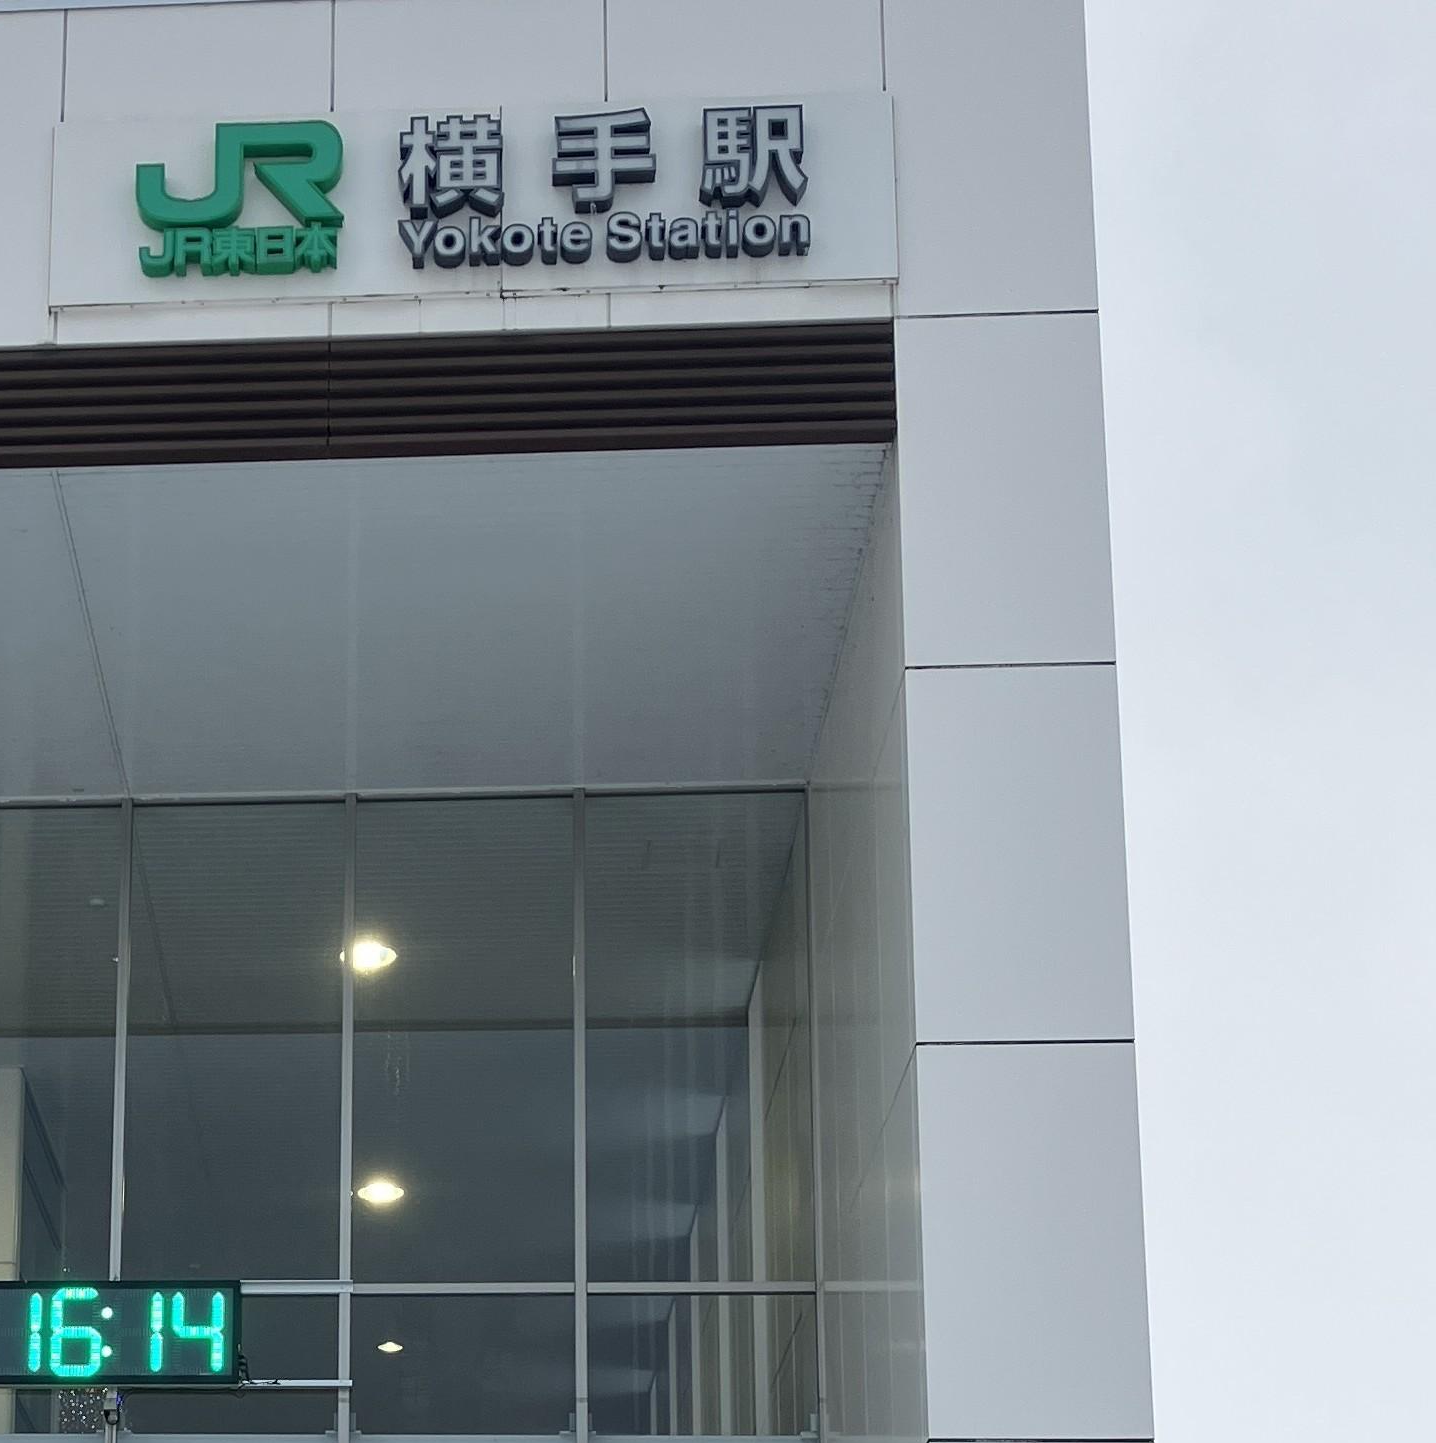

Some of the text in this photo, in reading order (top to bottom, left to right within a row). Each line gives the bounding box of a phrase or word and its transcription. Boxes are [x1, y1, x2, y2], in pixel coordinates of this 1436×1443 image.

[135, 118, 344, 231] JR
[398, 103, 810, 212] 横手駅
[138, 221, 340, 279] JR東日本
[398, 208, 814, 270] Yokote Station
[27, 1285, 226, 1378] 16:14
